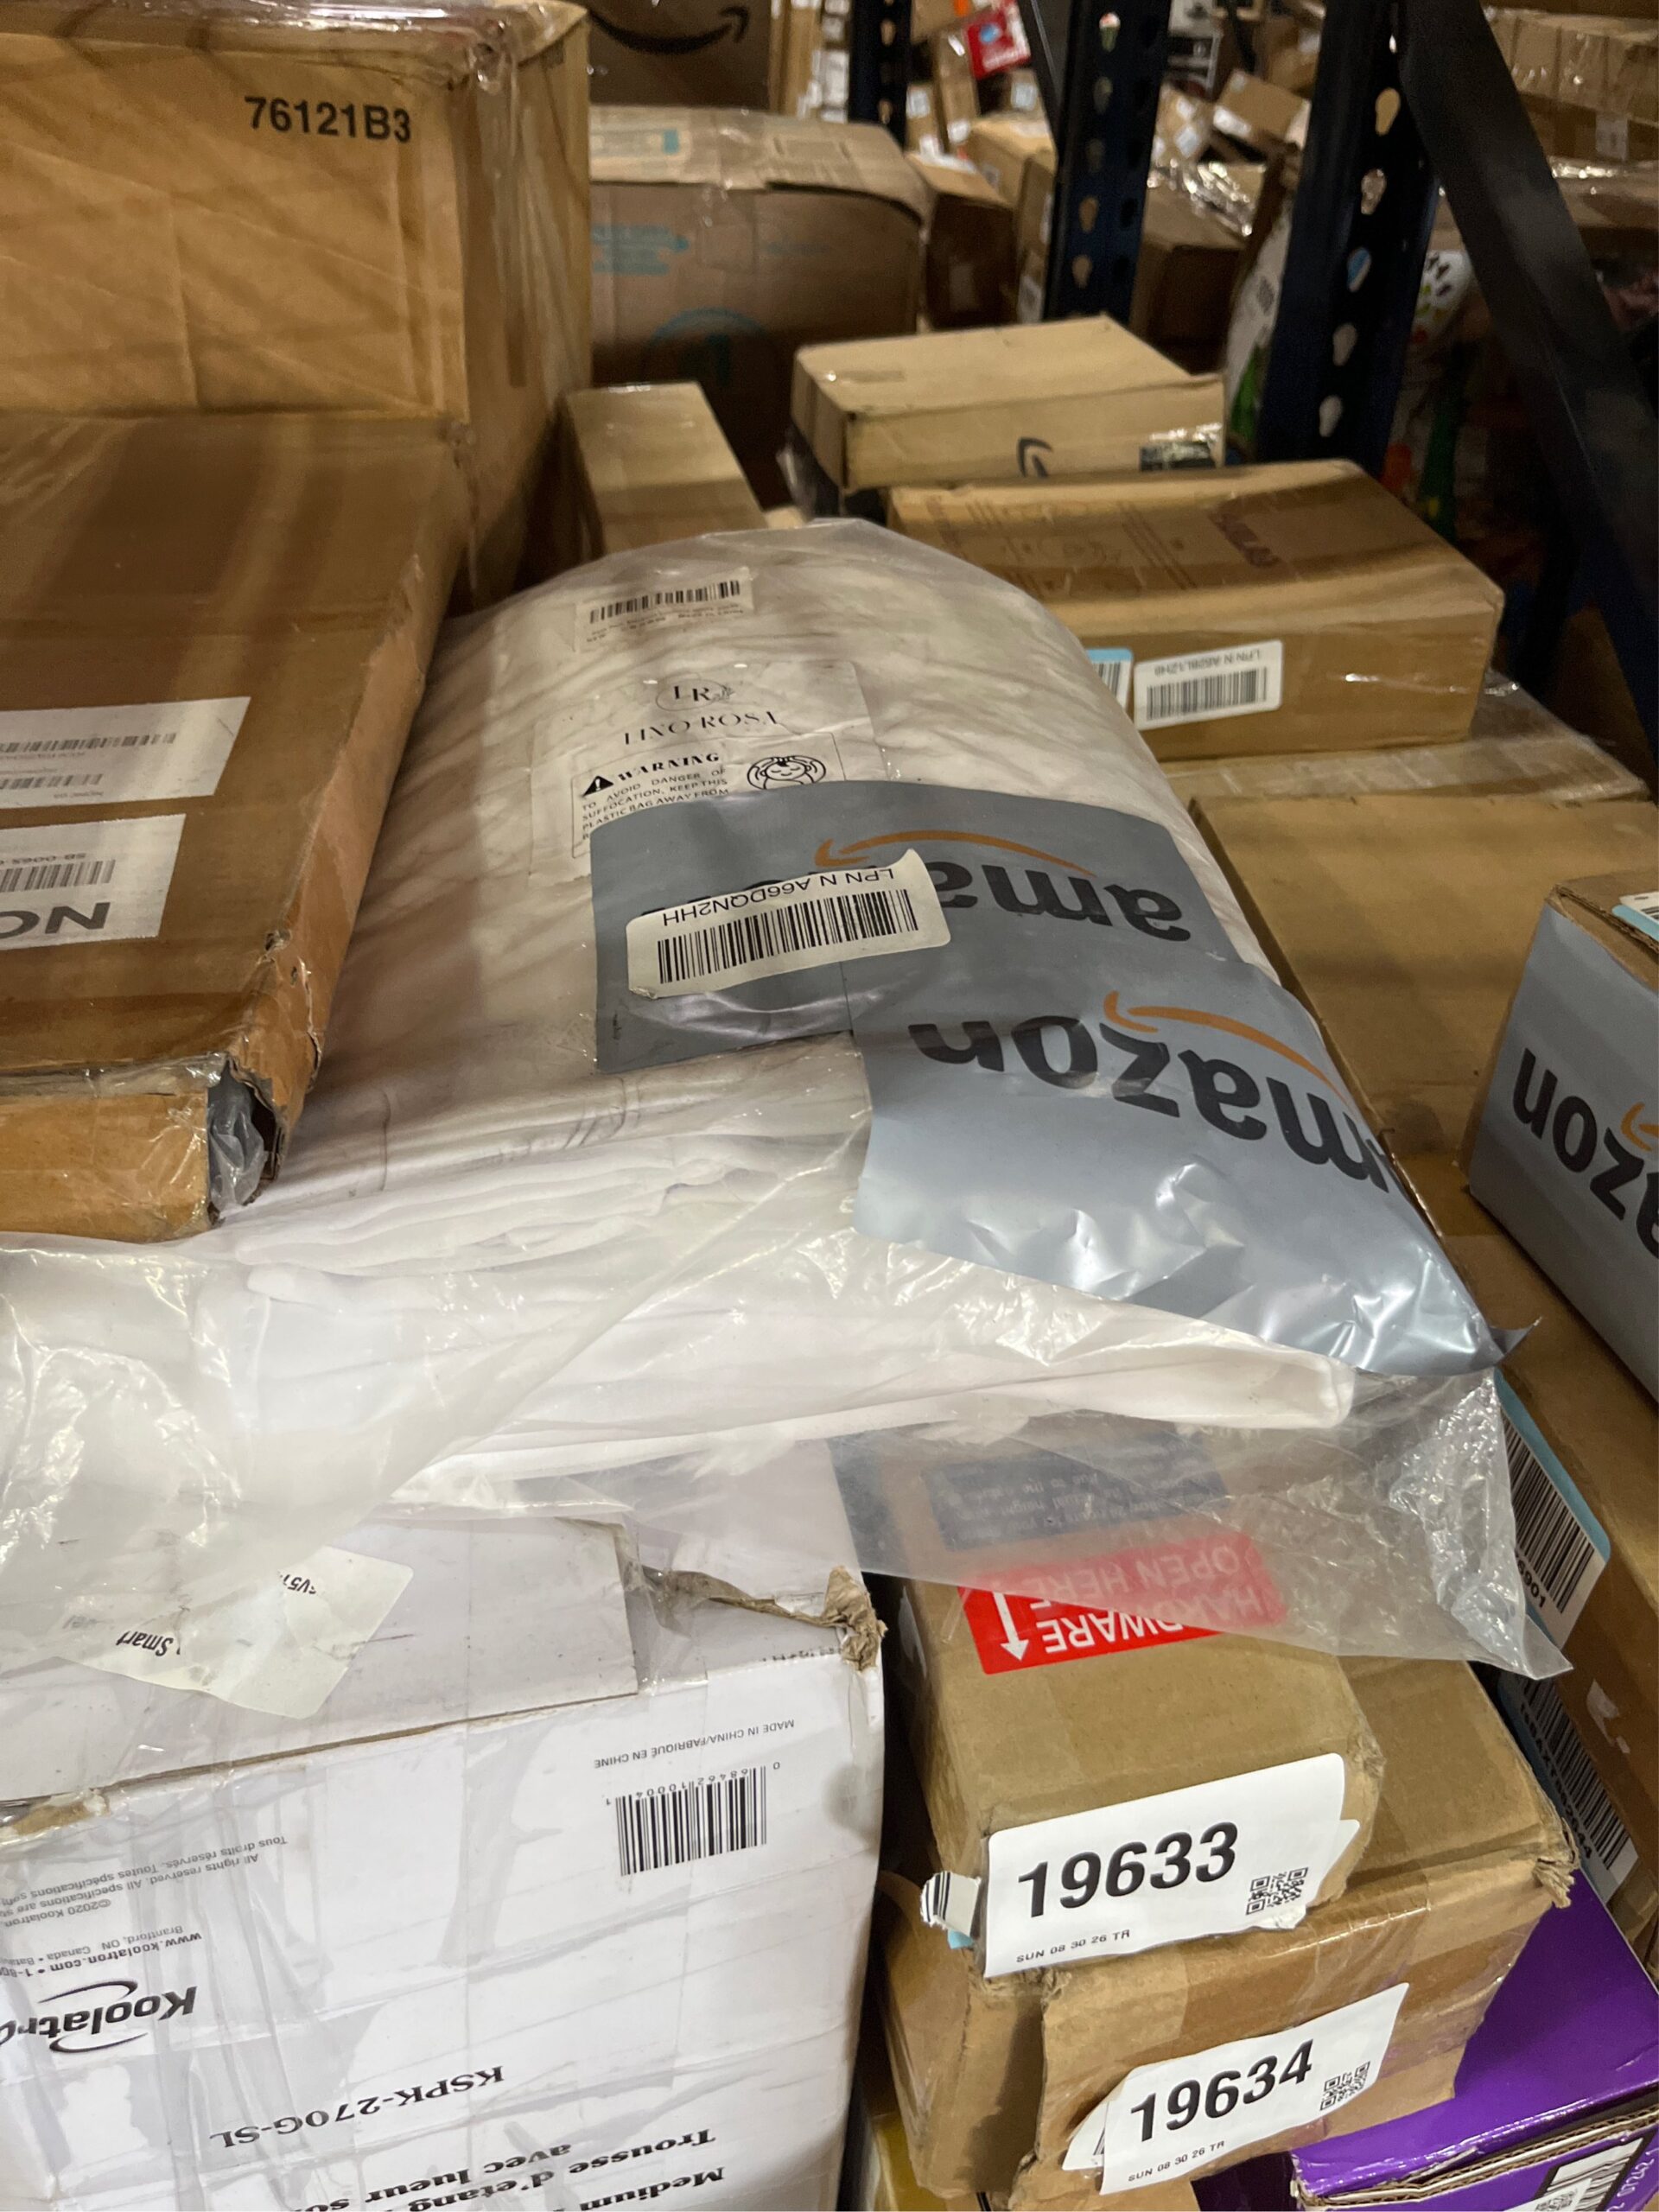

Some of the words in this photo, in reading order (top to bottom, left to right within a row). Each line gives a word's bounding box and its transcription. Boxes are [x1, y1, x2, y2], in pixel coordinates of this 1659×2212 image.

[244, 96, 412, 143] 76121B3
[617, 753, 720, 782] WARNING
[582, 801, 597, 811] TO
[606, 783, 642, 802] AVOID
[651, 772, 702, 786] DANGER
[710, 766, 727, 777] OF
[670, 780, 699, 792] KEEP
[701, 778, 728, 788] THIS
[582, 805, 628, 831] PLASTIC
[629, 800, 654, 812] BAG
[656, 792, 692, 805] AWAY
[694, 788, 730, 799] FROM
[819, 873, 838, 887] N
[844, 868, 895, 885] LPN
[662, 877, 811, 927] A66DQN2HH
[1135, 1545, 1241, 1591] OPEN
[1020, 1560, 1132, 1611] HERE
[1035, 1586, 1268, 1655] HARDWARE
[747, 1726, 760, 1737] IN
[763, 1719, 796, 1733] MADE
[632, 1749, 648, 1761] EN
[651, 1729, 745, 1758] CHINA/FABRIQUÉ
[594, 1752, 630, 1769] CHINE
[219, 1841, 256, 1857] droits
[258, 1835, 288, 1848] Tous
[118, 1863, 159, 1878] Toutes
[205, 1856, 241, 1872] rights
[243, 1853, 259, 1865] All
[1016, 1821, 1240, 1919] 19633
[30, 1872, 115, 1897] spécifications
[126, 1878, 143, 1891] All
[145, 1866, 202, 1886] reserved.
[16, 1902, 37, 1914] are
[40, 1882, 124, 1908] specifications
[47, 1945, 92, 1961] Canada
[49, 1931, 203, 1972] www.koolatron.com
[101, 1938, 122, 1951] ON
[1015, 1949, 1045, 1963] SUN
[1049, 1944, 1066, 1955] 08
[1071, 1938, 1087, 1949] 30
[1090, 1934, 1108, 1944] 26
[1111, 1929, 1131, 1942] TR
[1129, 2038, 1314, 2144] 19634
[208, 2065, 505, 2149] KSPK-270G-SL
[483, 2143, 572, 2174] avec
[568, 2128, 716, 2175] Trousse
[1128, 2168, 1154, 2183] SUN
[1157, 2161, 1171, 2172] 08
[1174, 2153, 1189, 2165] 30
[1191, 2147, 1206, 2158] 26
[1209, 2139, 1225, 2152] TR
[365, 2168, 470, 2203] lueur
[579, 2166, 726, 2212] Medium
